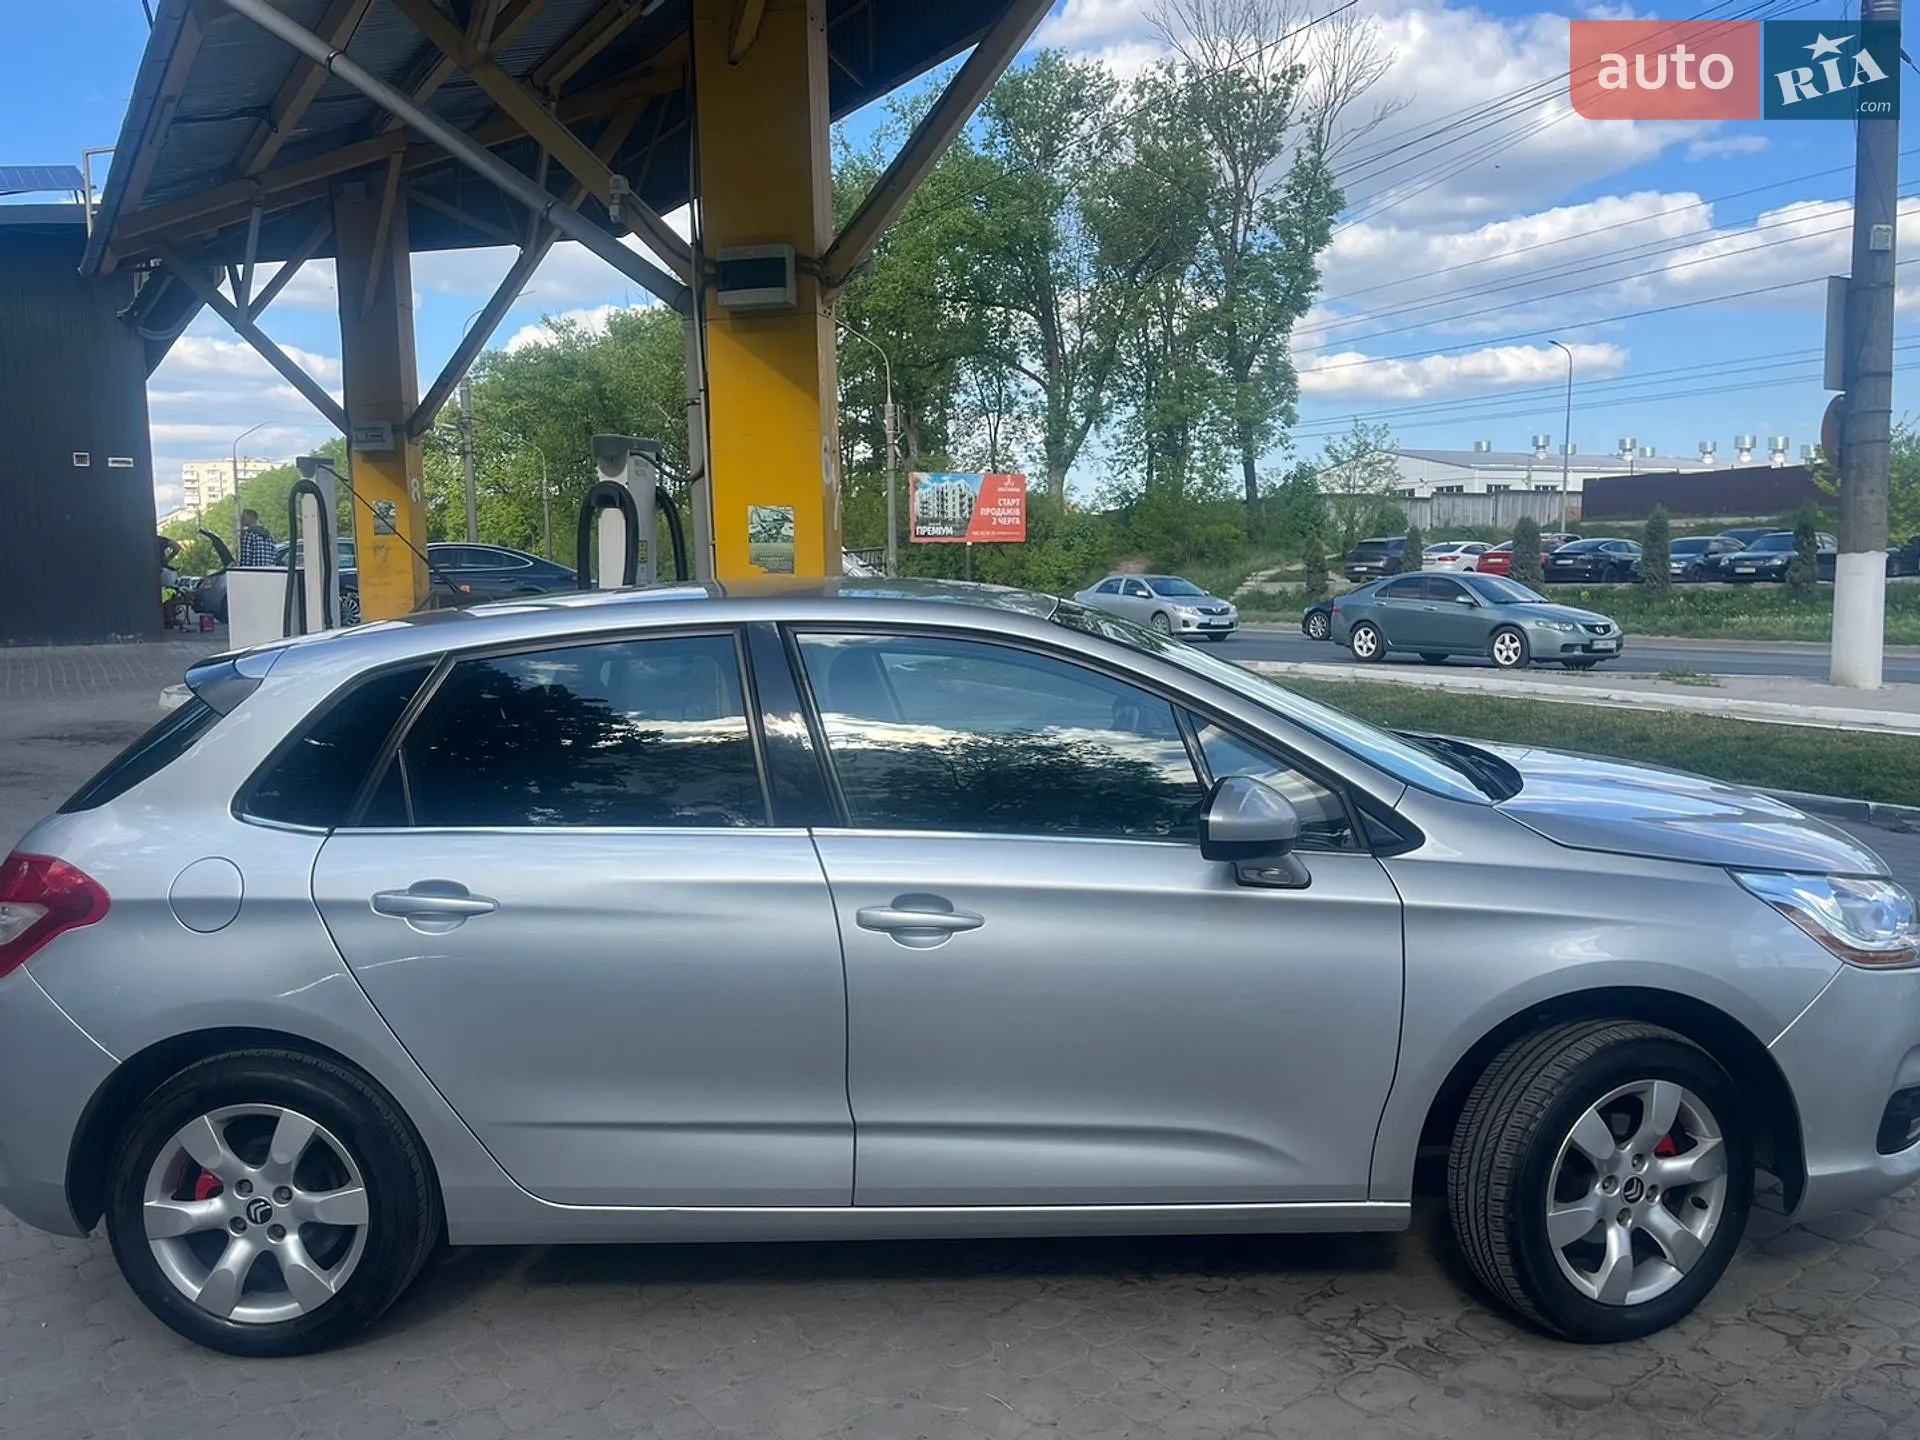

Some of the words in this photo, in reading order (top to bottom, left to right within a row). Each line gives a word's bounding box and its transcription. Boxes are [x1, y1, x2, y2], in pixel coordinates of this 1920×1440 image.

[998, 498, 1020, 507] СТАРТ
[980, 507, 1020, 516] ПРОДАЖІВ
[992, 517, 997, 525] 2
[998, 517, 1020, 526] ЧЕРГА
[916, 527, 953, 536] ПРЕМІУМ
